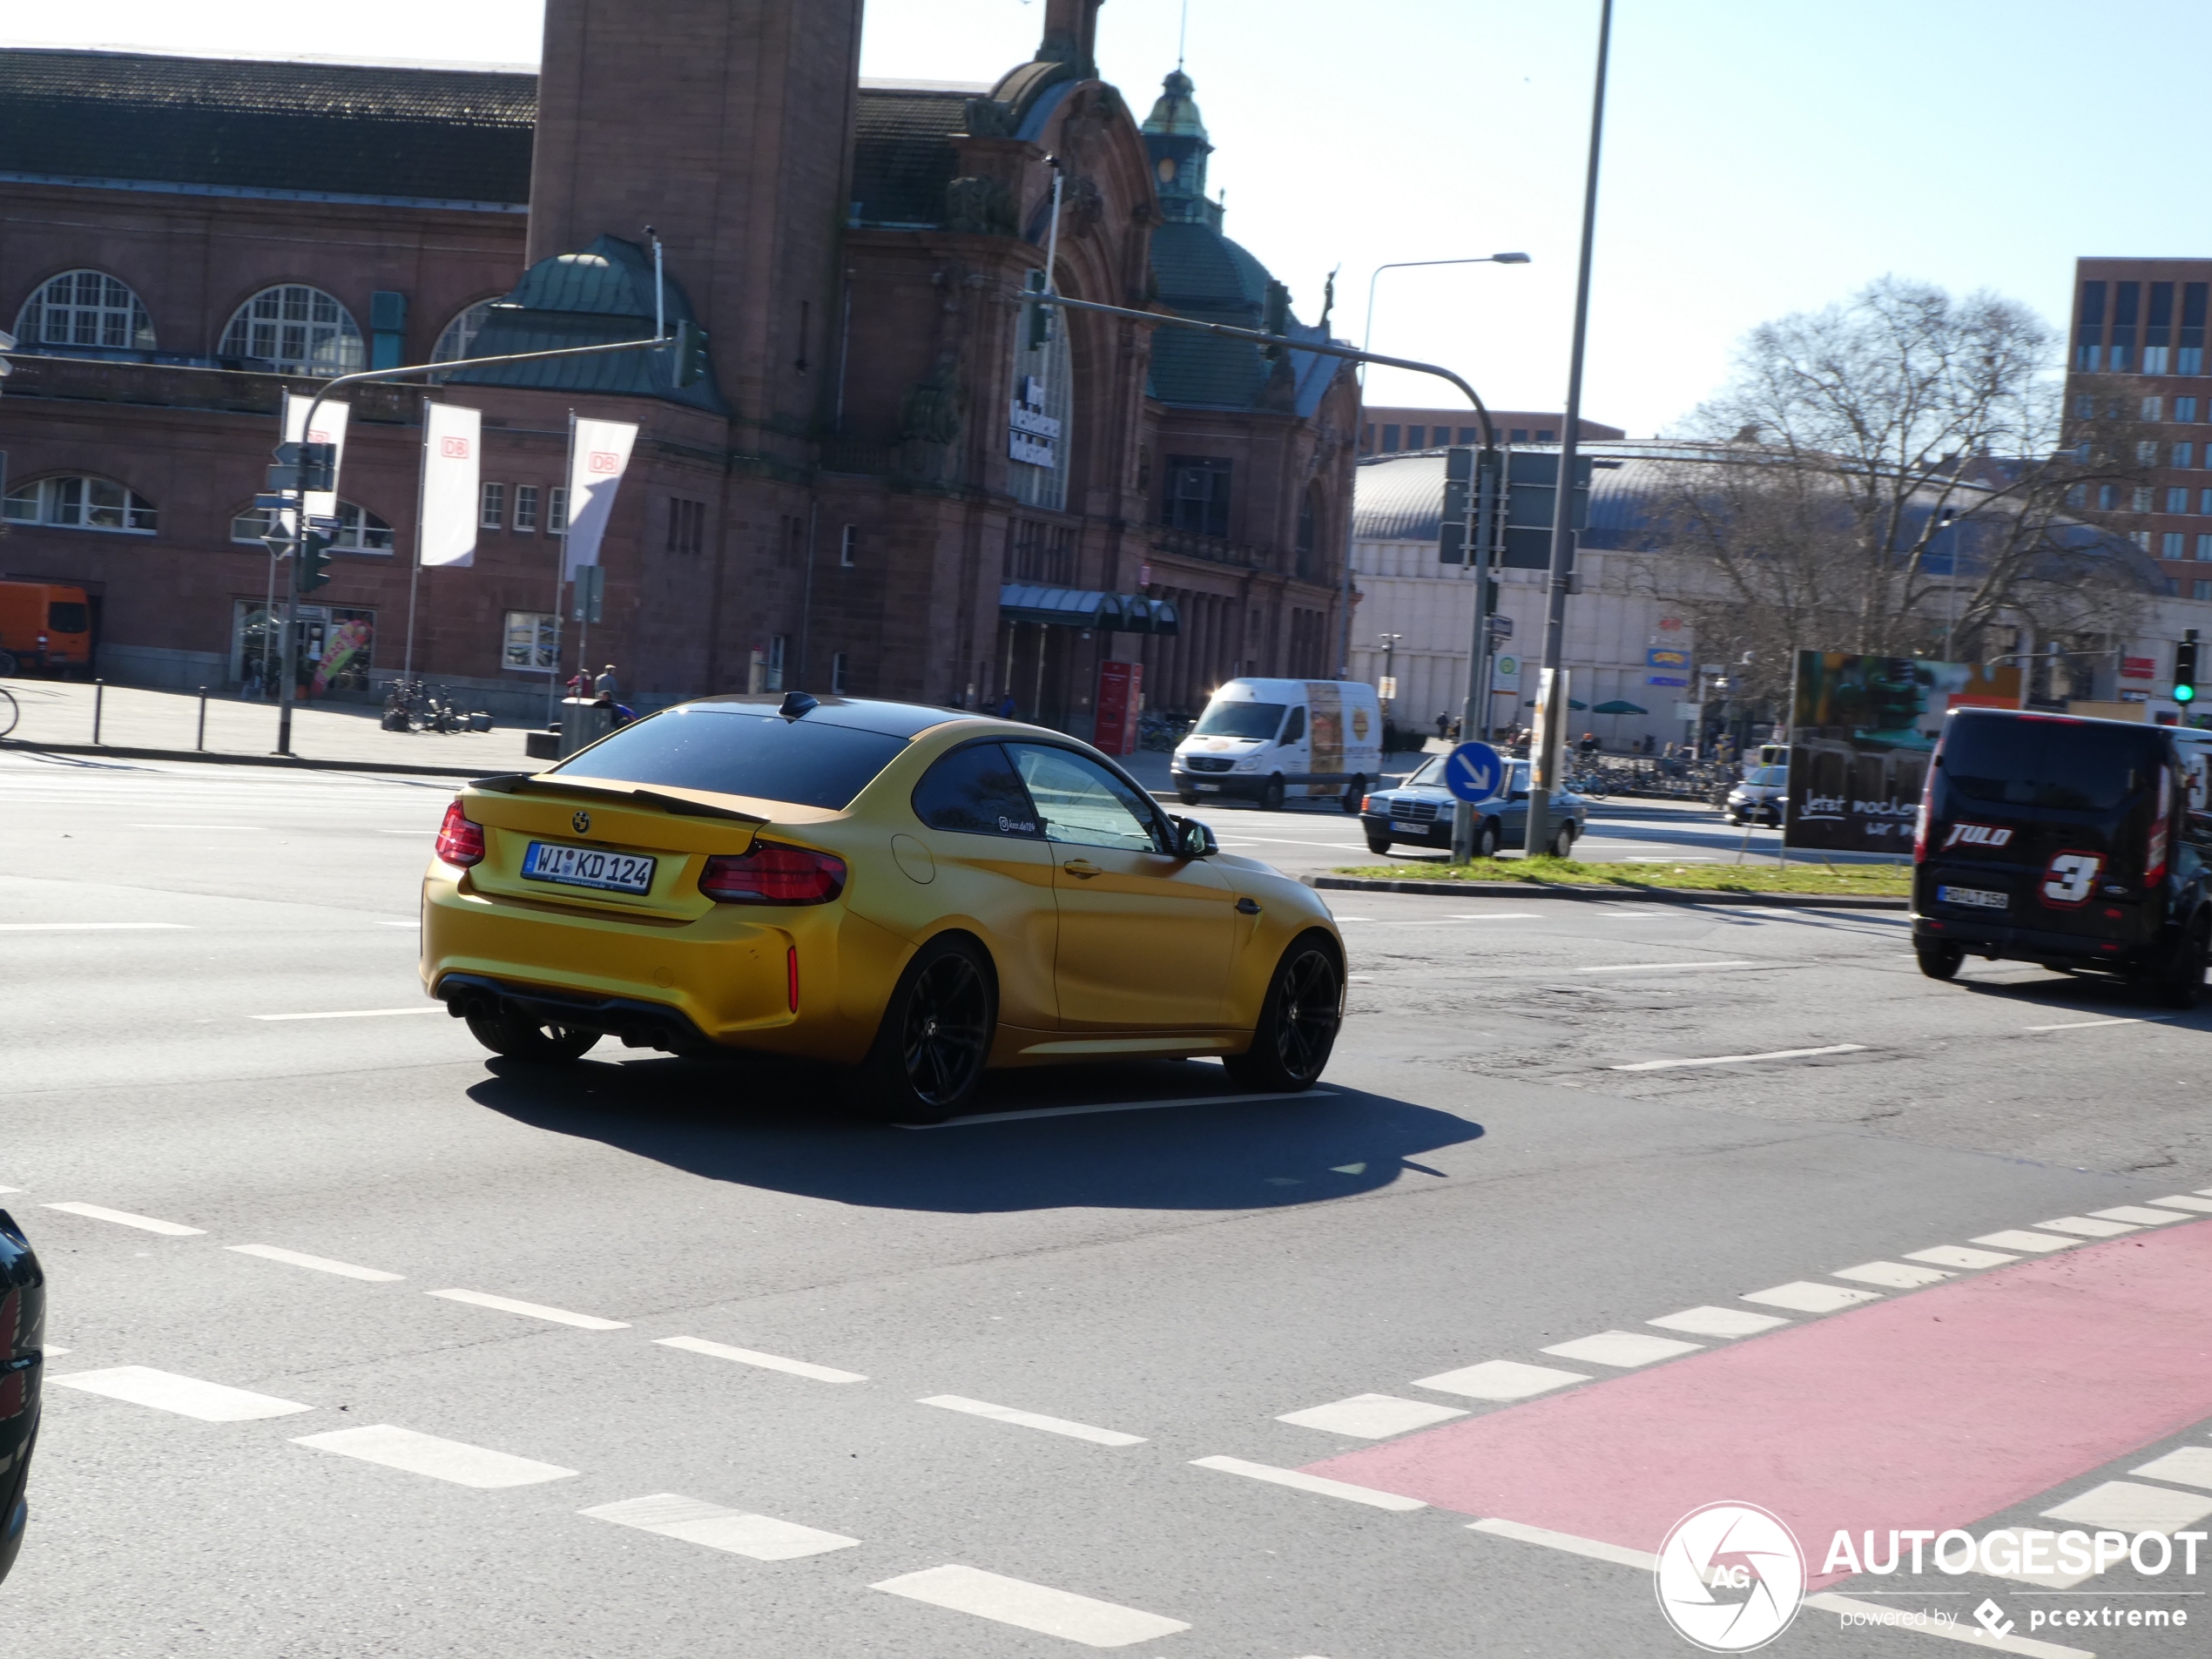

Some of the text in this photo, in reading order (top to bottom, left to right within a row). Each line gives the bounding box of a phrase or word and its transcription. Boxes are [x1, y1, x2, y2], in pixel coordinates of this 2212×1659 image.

[445, 439, 465, 455] DB
[592, 455, 616, 470] DB
[1800, 788, 1847, 816] Jetzt
[1945, 823, 2013, 846] TULO
[536, 847, 649, 886] WI KD 124
[2043, 854, 2101, 901] 3
